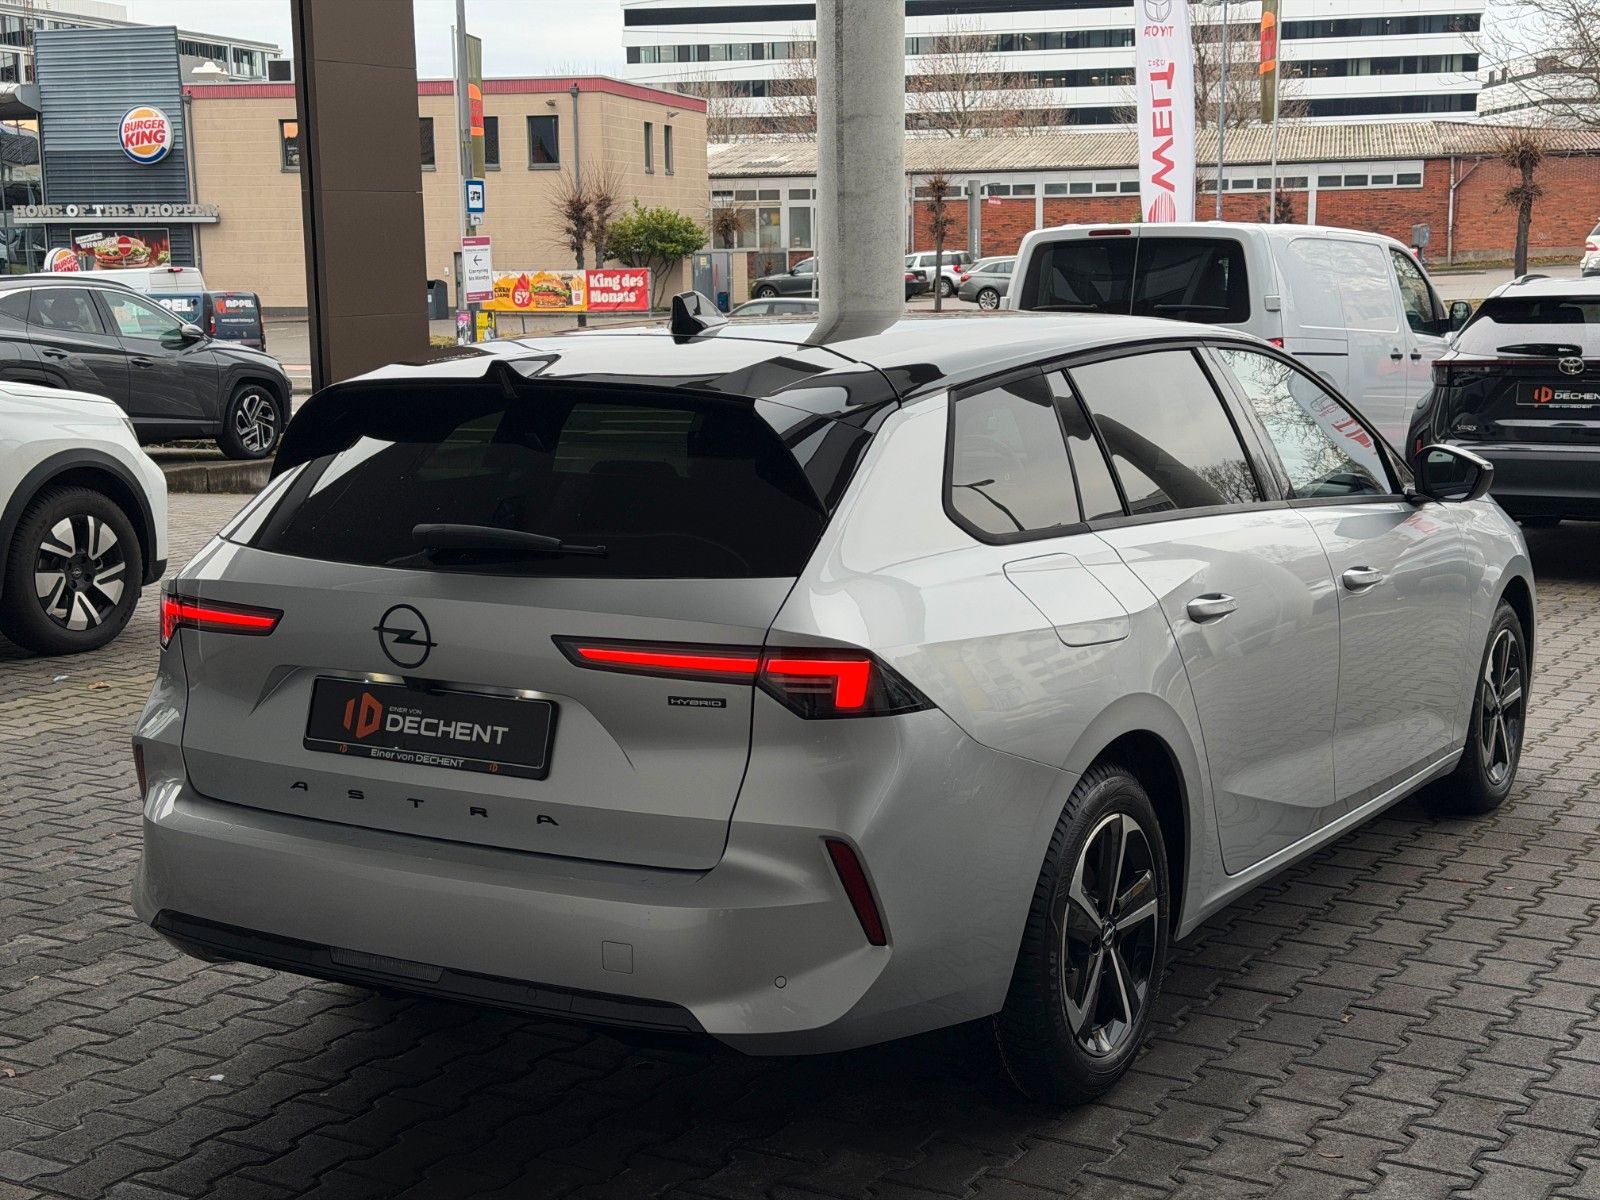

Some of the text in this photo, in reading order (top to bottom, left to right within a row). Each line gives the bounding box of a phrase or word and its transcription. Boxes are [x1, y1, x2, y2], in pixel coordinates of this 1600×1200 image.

[124, 119, 165, 133] BURGER
[125, 129, 166, 148] KING
[12, 203, 218, 218] HOME OF THE WHOPPER
[53, 255, 77, 272] BURGER
[589, 273, 644, 291] King des
[590, 290, 636, 303] Monats
[671, 698, 722, 707] HYBRID
[385, 713, 509, 745] DECHENT
[370, 748, 465, 768] Einer von DECHENT
